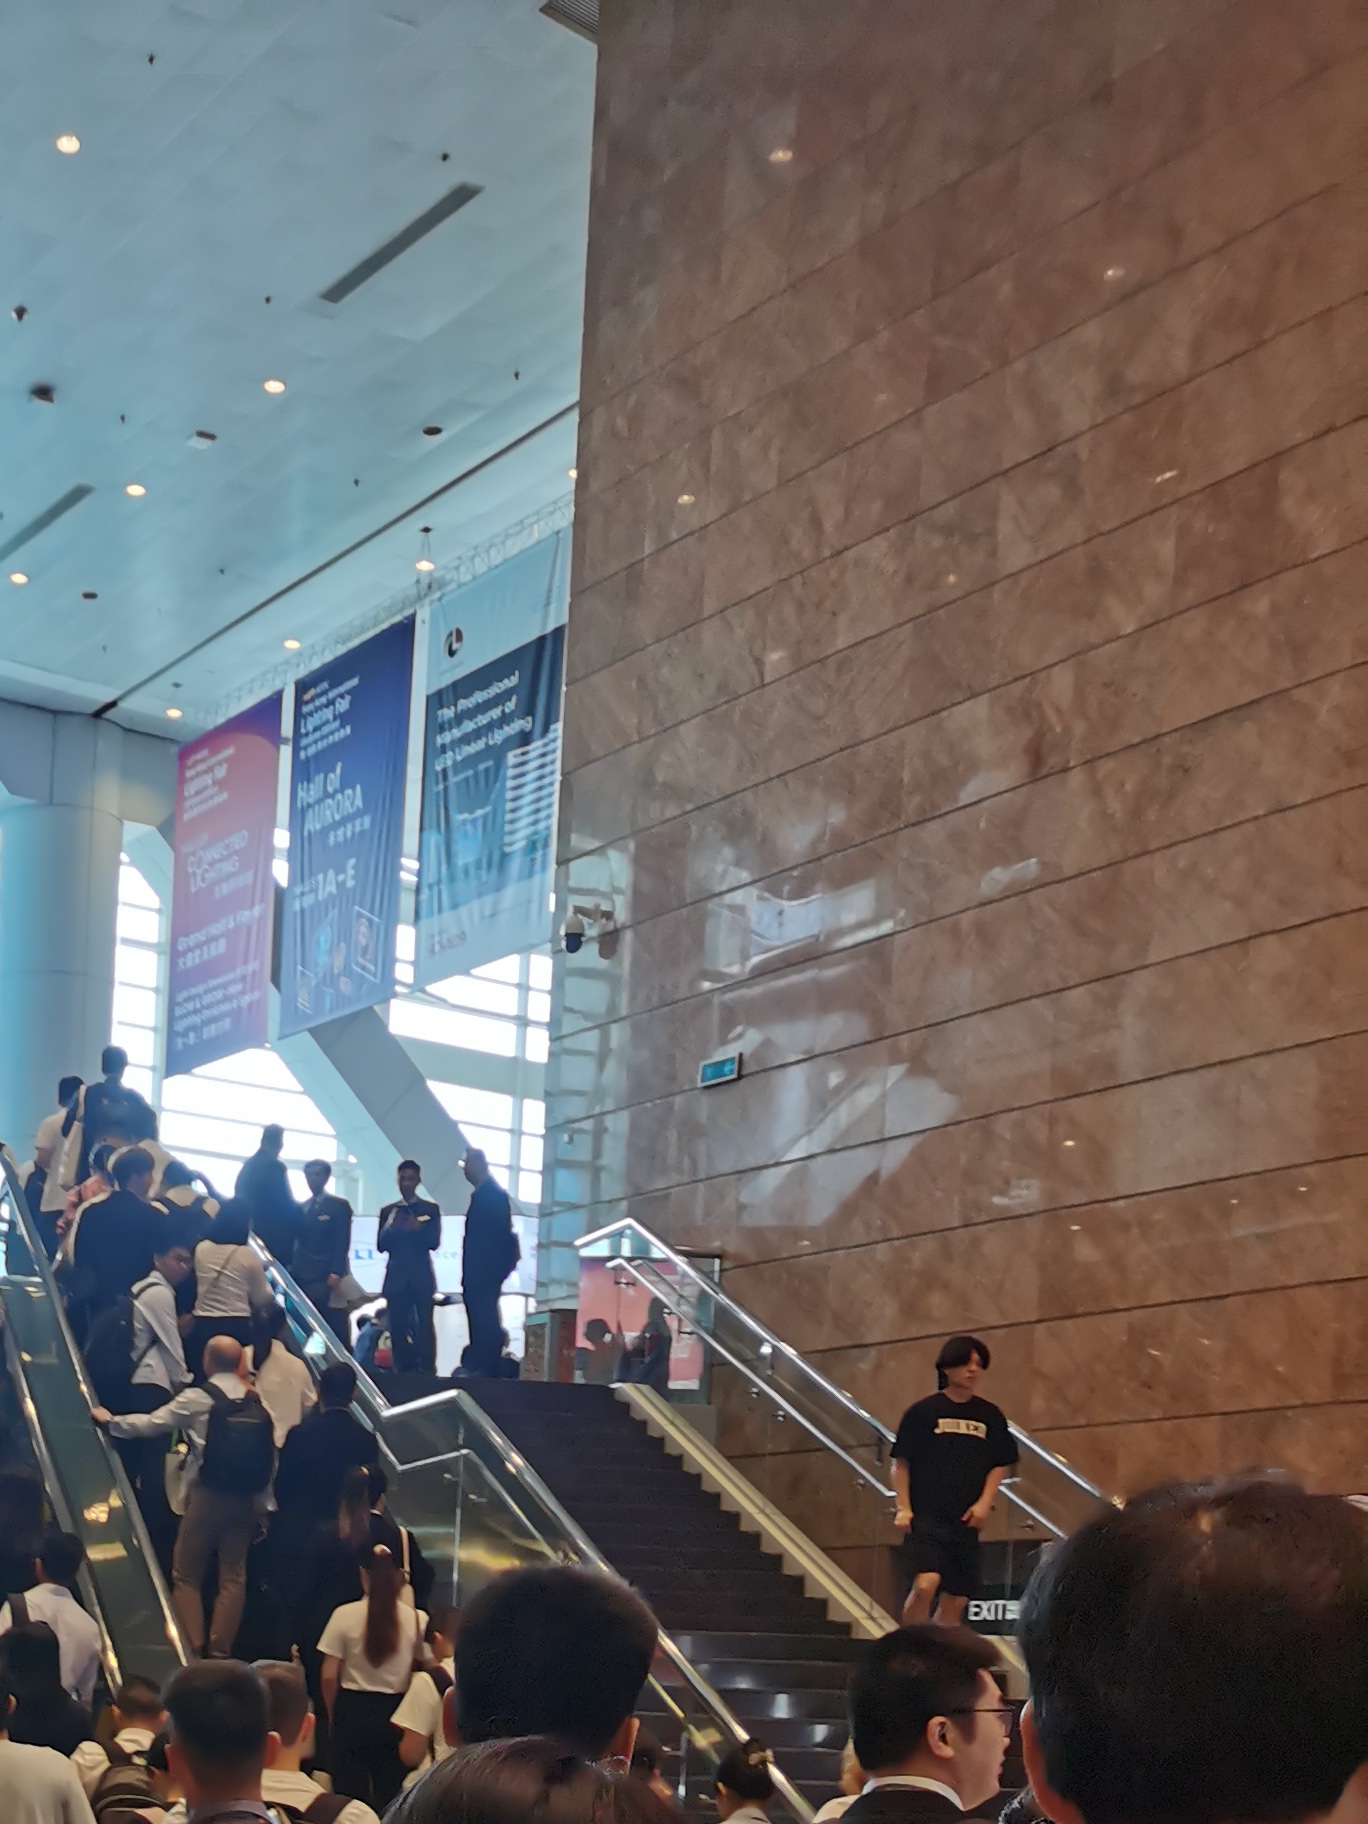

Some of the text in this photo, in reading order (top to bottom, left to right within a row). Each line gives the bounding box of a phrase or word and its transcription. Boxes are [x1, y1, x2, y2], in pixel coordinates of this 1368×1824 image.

[457, 669, 519, 713] Professional
[488, 716, 532, 746] Lighting
[297, 761, 342, 809] Hall of
[304, 783, 363, 836] AURORA
[317, 857, 357, 901] 1A-E
[968, 1599, 1007, 1620] EXIT
